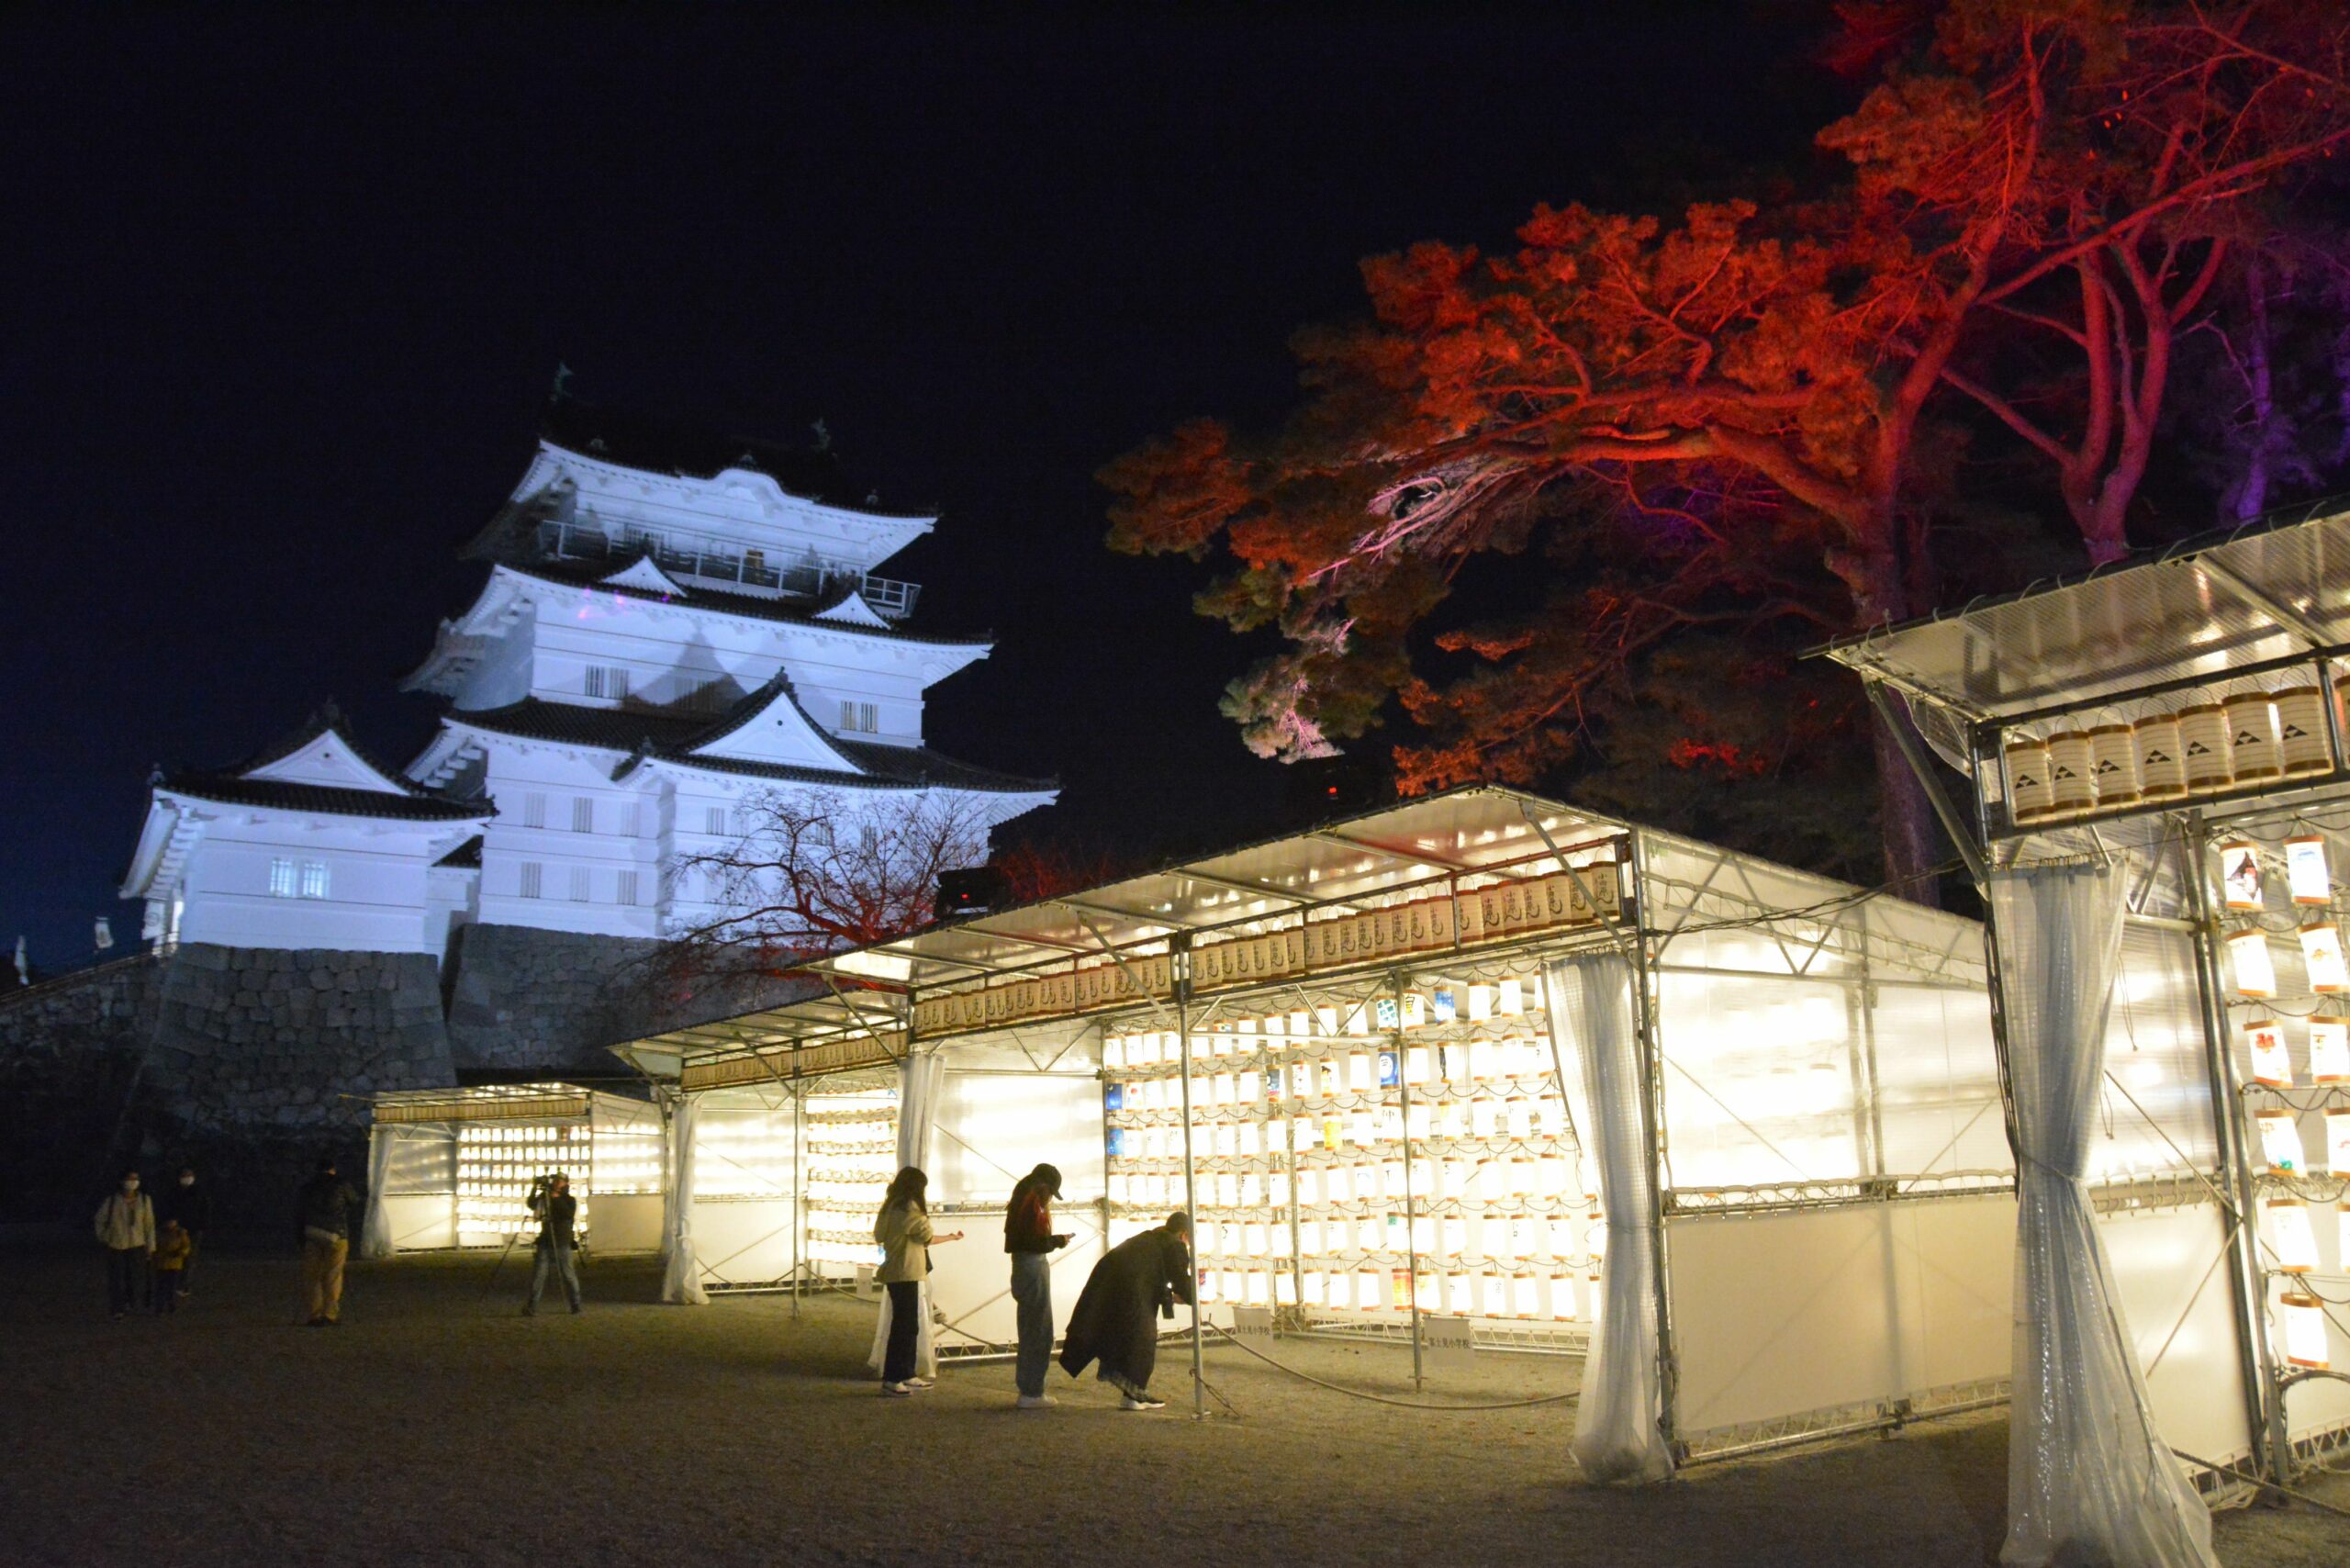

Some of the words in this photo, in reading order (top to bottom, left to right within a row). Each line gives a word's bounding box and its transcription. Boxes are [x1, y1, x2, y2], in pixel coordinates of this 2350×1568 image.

[1428, 1337, 1471, 1350] 富士見小学校
